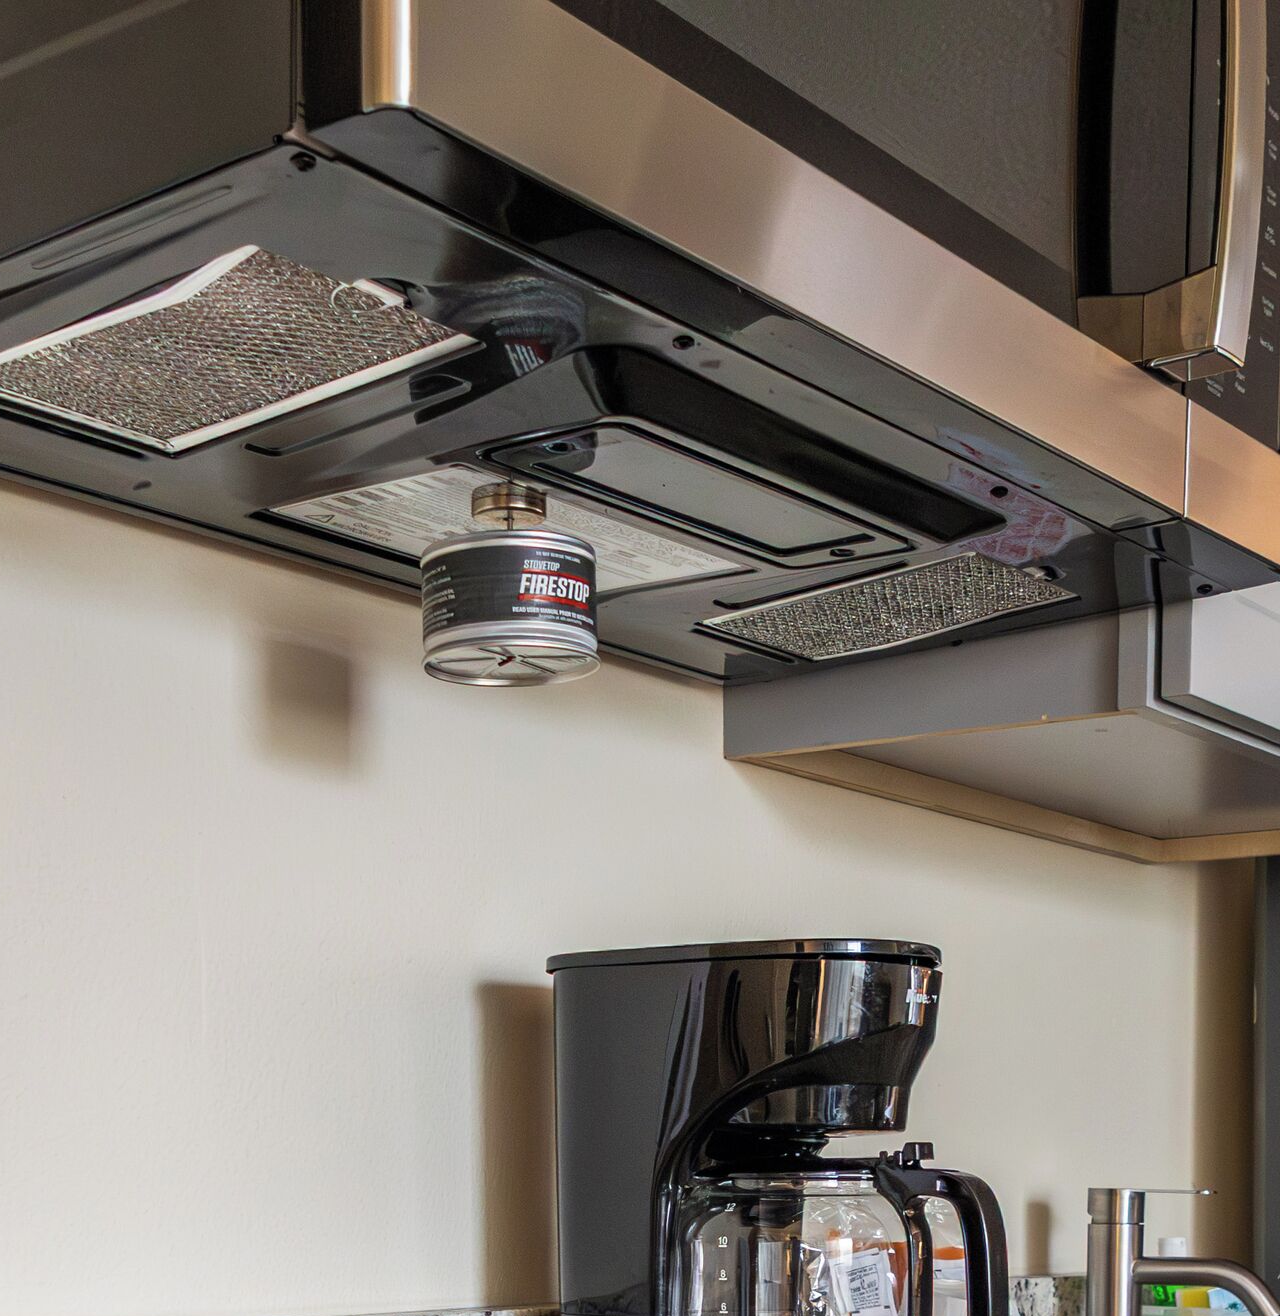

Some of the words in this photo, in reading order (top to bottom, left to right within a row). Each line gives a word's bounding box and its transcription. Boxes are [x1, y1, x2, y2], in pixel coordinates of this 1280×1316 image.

[523, 559, 560, 571] STOVETOP
[519, 573, 590, 604] FIRESTOP
[725, 1202, 737, 1211] 12
[718, 1236, 728, 1245] 10
[720, 1269, 726, 1278] 8
[721, 1302, 727, 1311] 6
